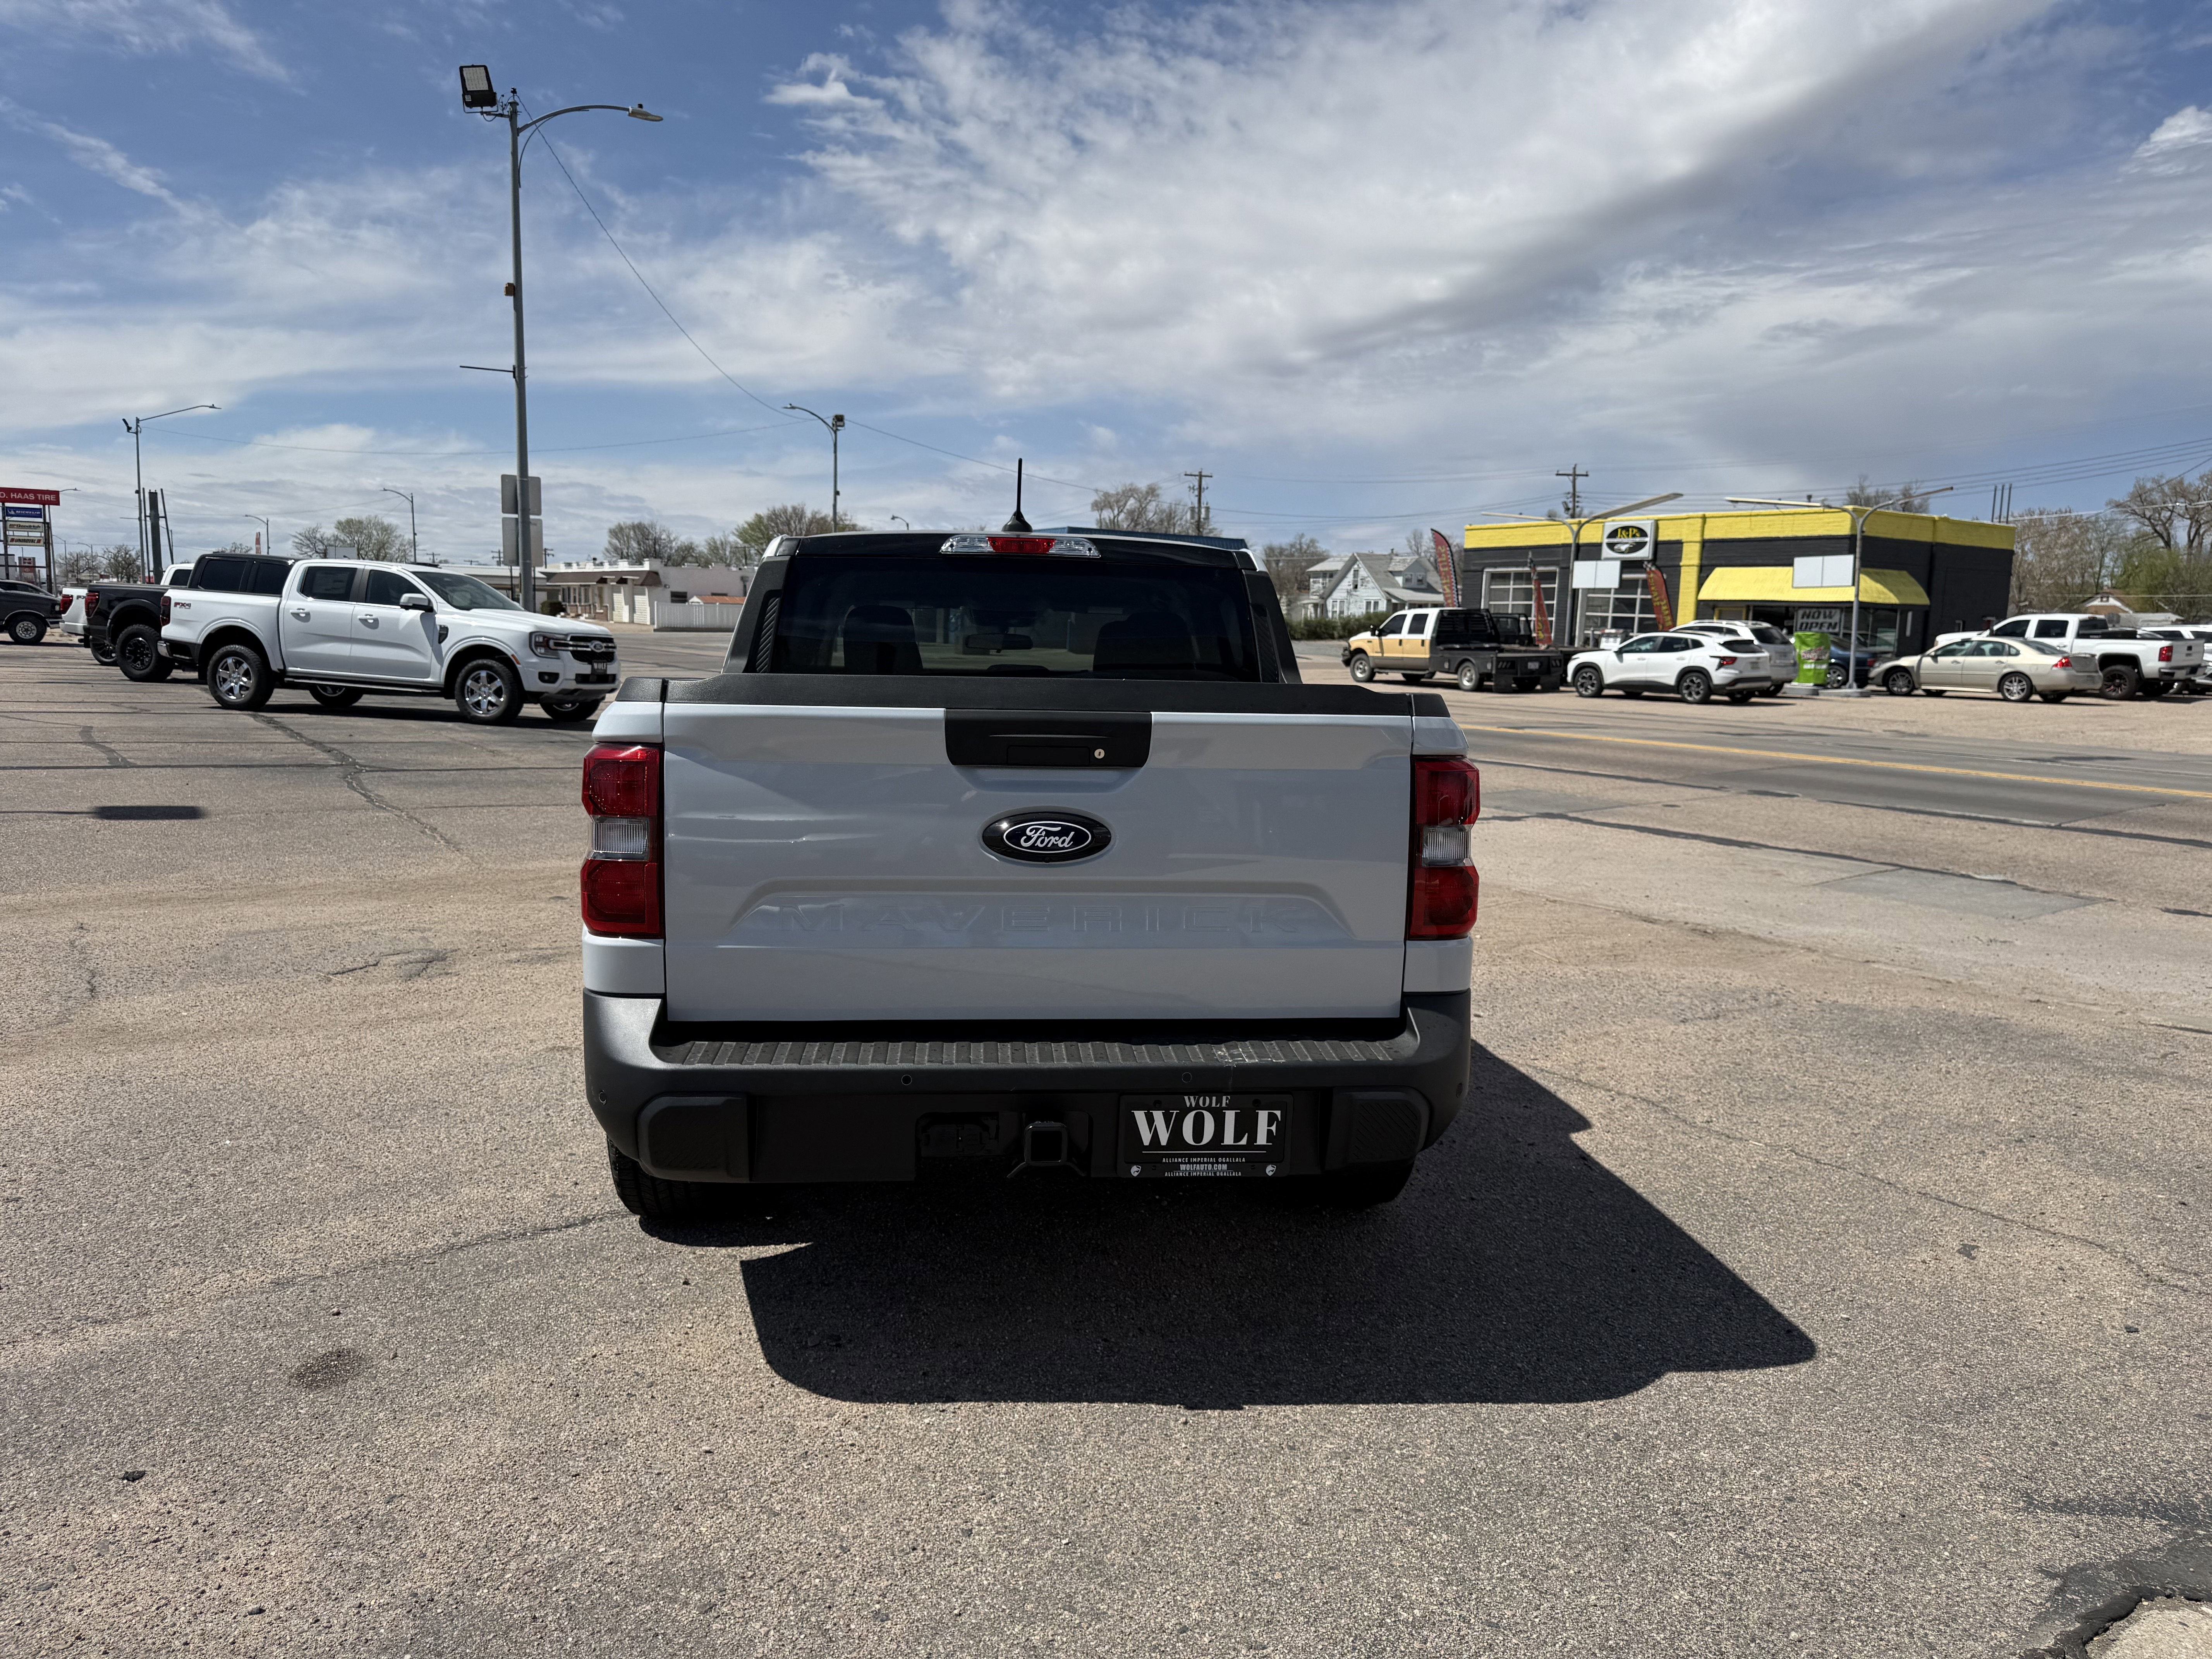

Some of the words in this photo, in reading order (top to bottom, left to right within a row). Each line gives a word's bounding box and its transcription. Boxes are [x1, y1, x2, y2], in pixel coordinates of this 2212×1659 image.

[1802, 611, 1836, 619] NOW
[1799, 622, 1838, 630] OPEN
[1020, 826, 1075, 847] Ford
[779, 904, 1299, 933] MAVERICK
[1184, 1096, 1230, 1107] WOLF
[1131, 1110, 1281, 1146] WOLF
